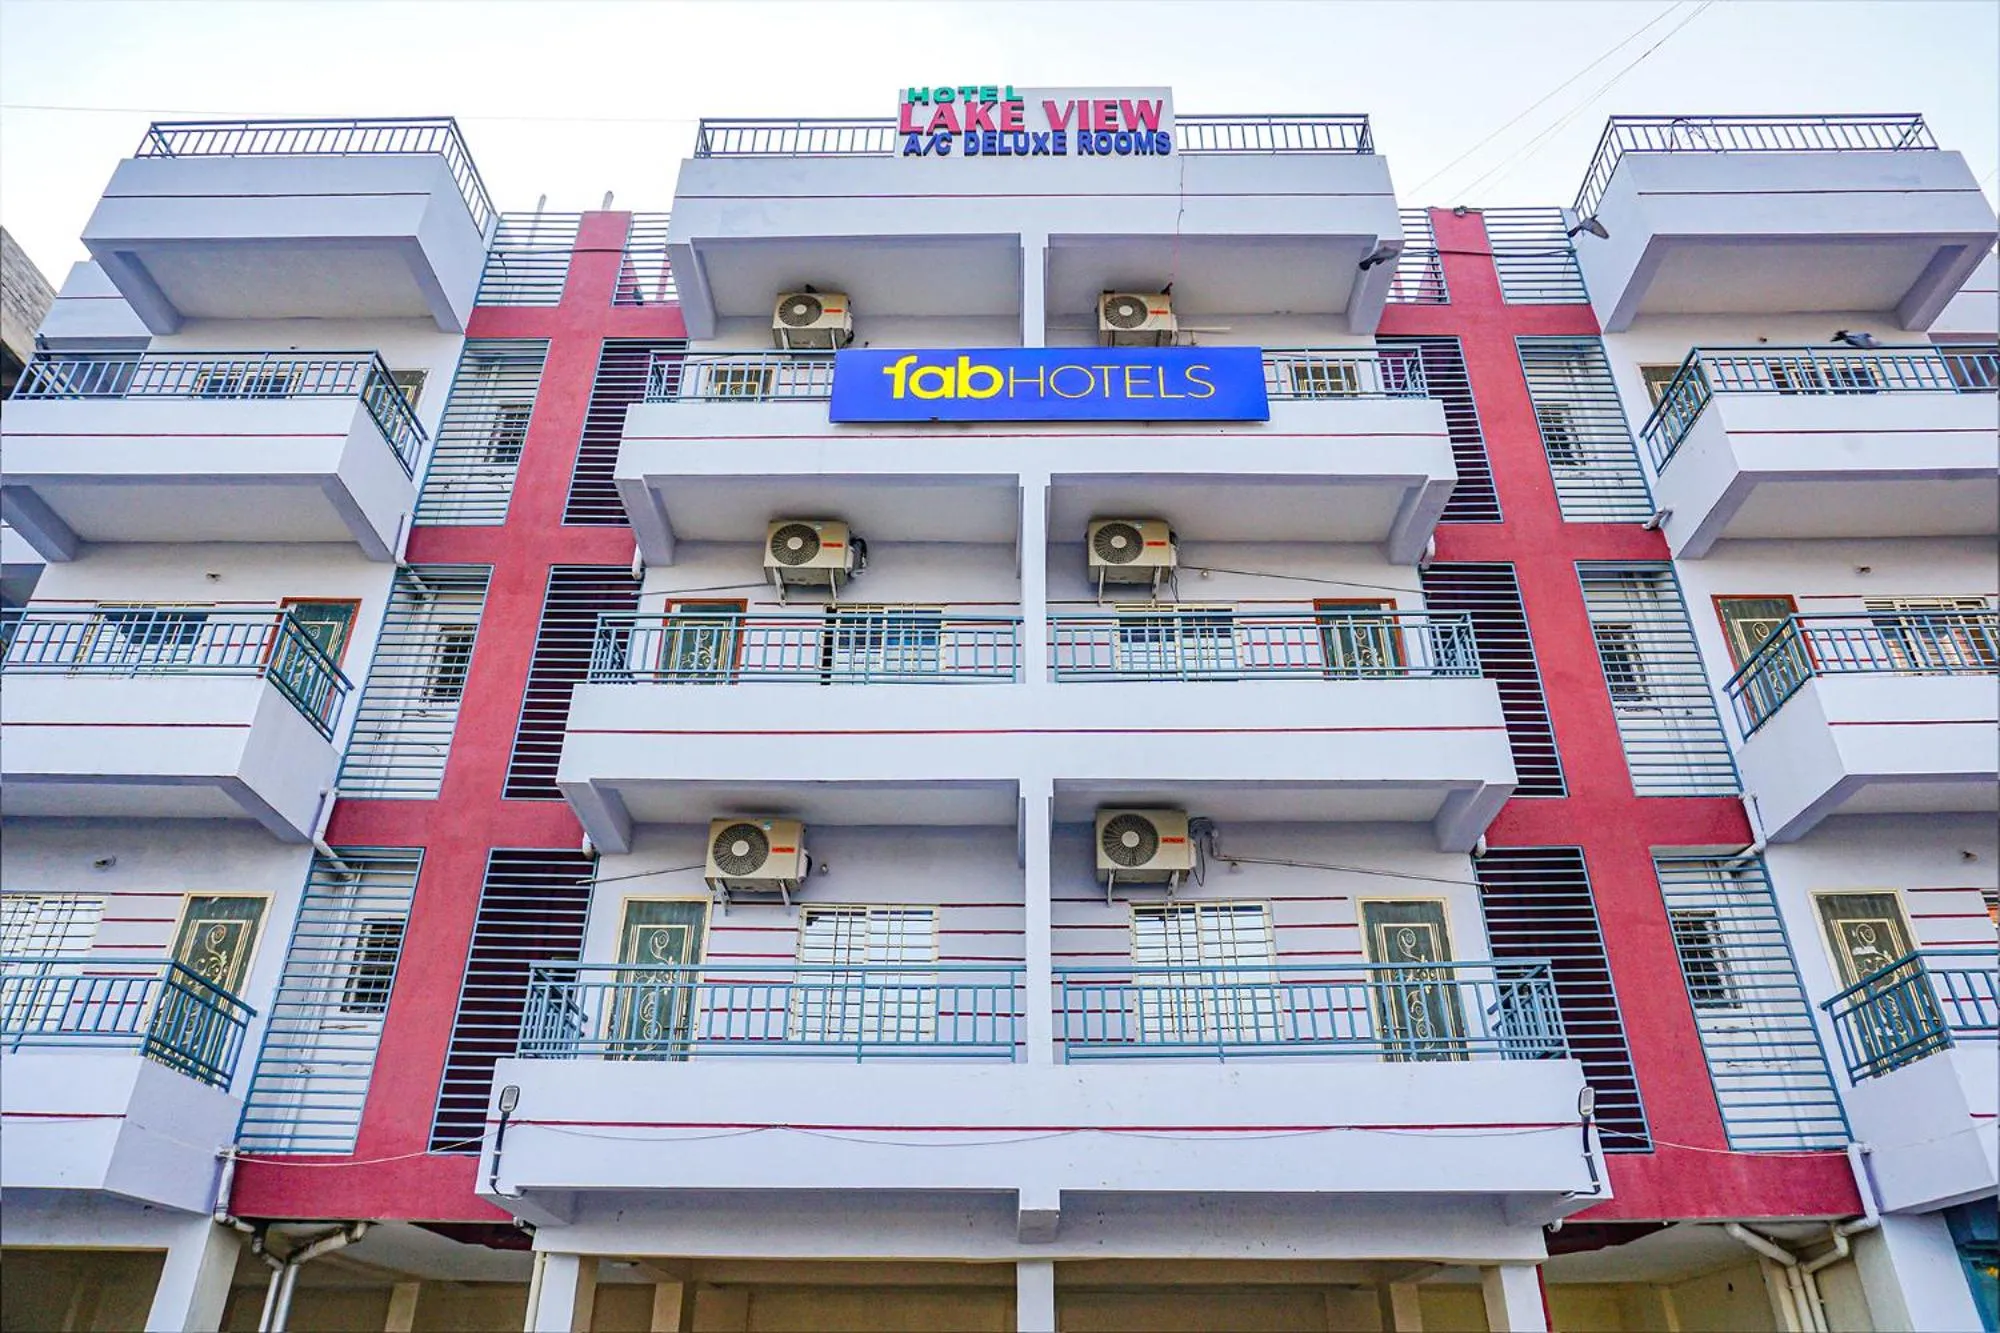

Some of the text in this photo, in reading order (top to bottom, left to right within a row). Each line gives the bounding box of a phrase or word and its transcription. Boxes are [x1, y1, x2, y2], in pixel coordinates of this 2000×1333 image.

[908, 85, 1024, 106] HOTEL
[899, 99, 1164, 136] LAKE VIEW
[903, 130, 1172, 157] A/C DELUXE ROOMS
